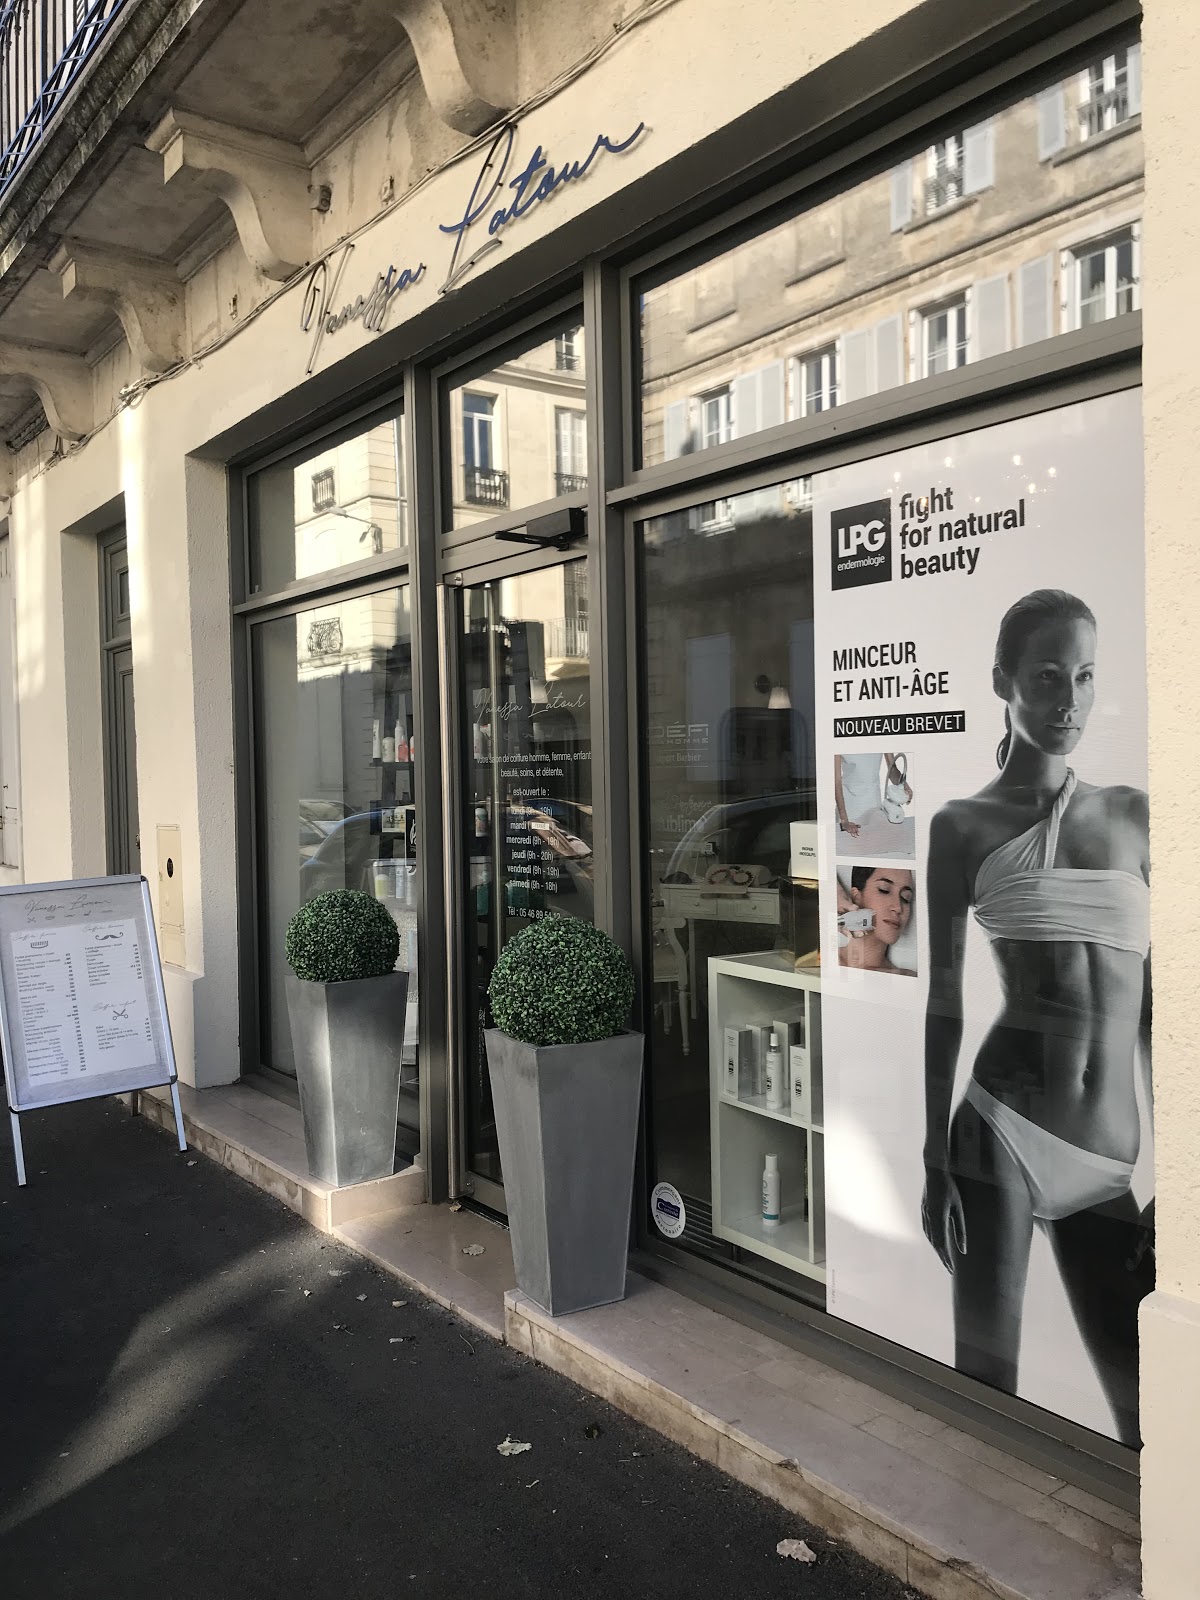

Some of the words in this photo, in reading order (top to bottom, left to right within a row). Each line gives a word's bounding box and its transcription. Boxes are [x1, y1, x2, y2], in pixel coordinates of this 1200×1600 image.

[300, 242, 427, 376] Vanessa
[438, 121, 647, 295] Latour
[899, 487, 954, 523] fight
[899, 523, 932, 549] for
[938, 498, 1025, 543] natural
[837, 519, 887, 558] LPG
[837, 553, 886, 572] endermologie
[900, 547, 981, 580] beauty
[832, 641, 917, 671] MINCEUR
[833, 680, 853, 702] ET
[858, 668, 949, 700] ANTI-ÂGE
[836, 717, 901, 735] NOUVEAU
[905, 714, 962, 732] BREVET
[503, 754, 509, 763] de
[510, 753, 528, 763] coiffure
[529, 752, 551, 762] homme,
[551, 751, 572, 761] femme,
[676, 752, 702, 762] Barbier
[500, 767, 519, 777] beauté,
[519, 767, 535, 777] soins,
[535, 767, 541, 776] et
[542, 766, 564, 777] détente,
[510, 821, 526, 829] mardi
[506, 836, 532, 845] mercredi
[533, 836, 542, 847] (9h
[547, 836, 560, 848] 19h)
[511, 849, 526, 860] jeudi
[527, 851, 536, 861] (9h
[541, 852, 553, 862] 20h)
[507, 864, 532, 874] vendredi
[532, 865, 541, 876] (9h
[547, 866, 560, 878] 19h)
[509, 879, 530, 889] samedi
[531, 880, 540, 890] (9h
[546, 881, 558, 893] 18h)
[519, 908, 527, 917] 05
[527, 909, 535, 918] 46
